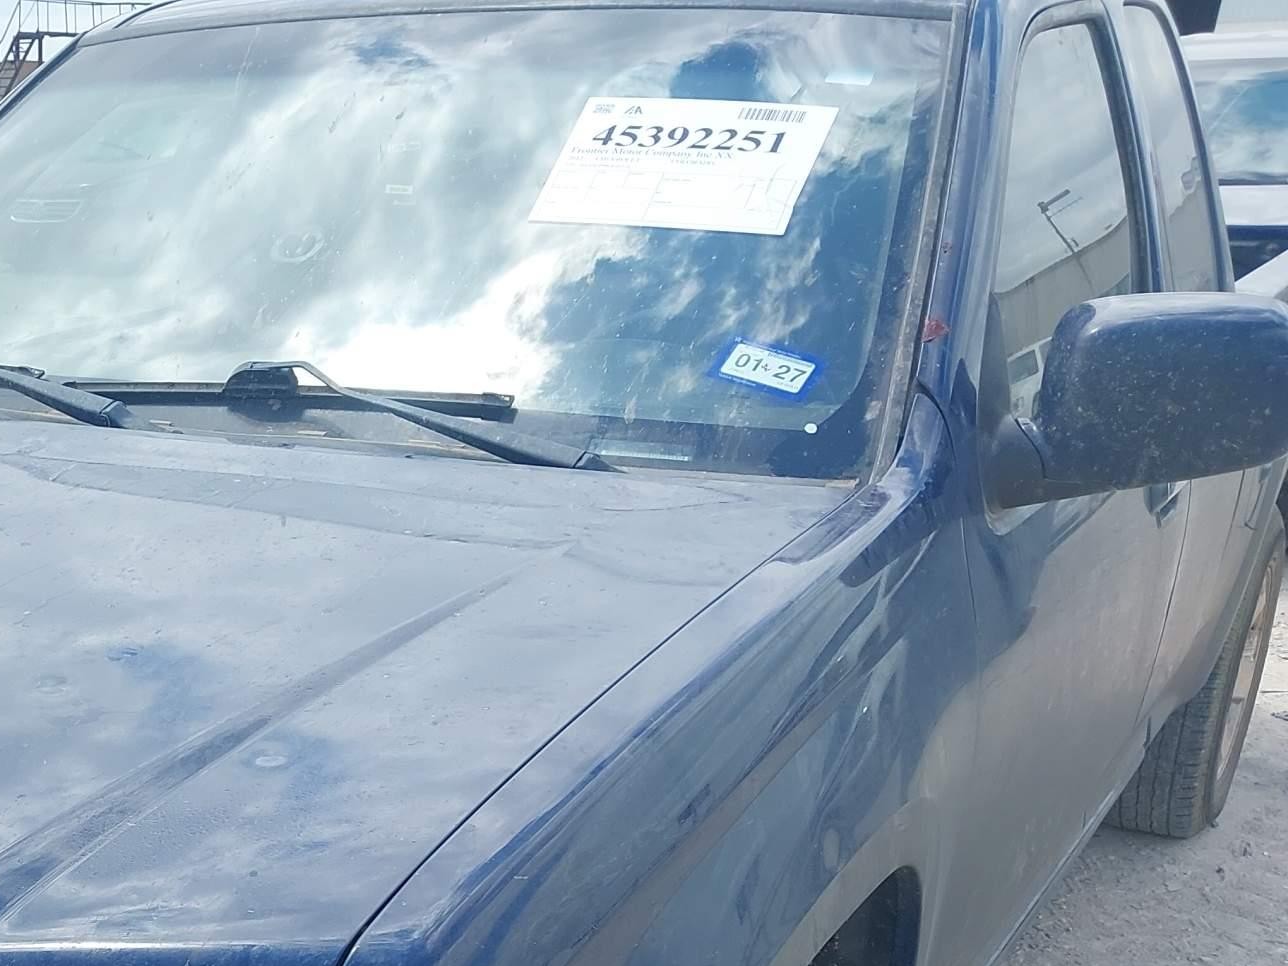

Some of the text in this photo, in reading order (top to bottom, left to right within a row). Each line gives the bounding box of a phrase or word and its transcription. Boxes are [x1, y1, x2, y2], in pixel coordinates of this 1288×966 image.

[592, 124, 787, 154] 45392251
[734, 353, 764, 372] 01
[772, 365, 807, 383] 27
